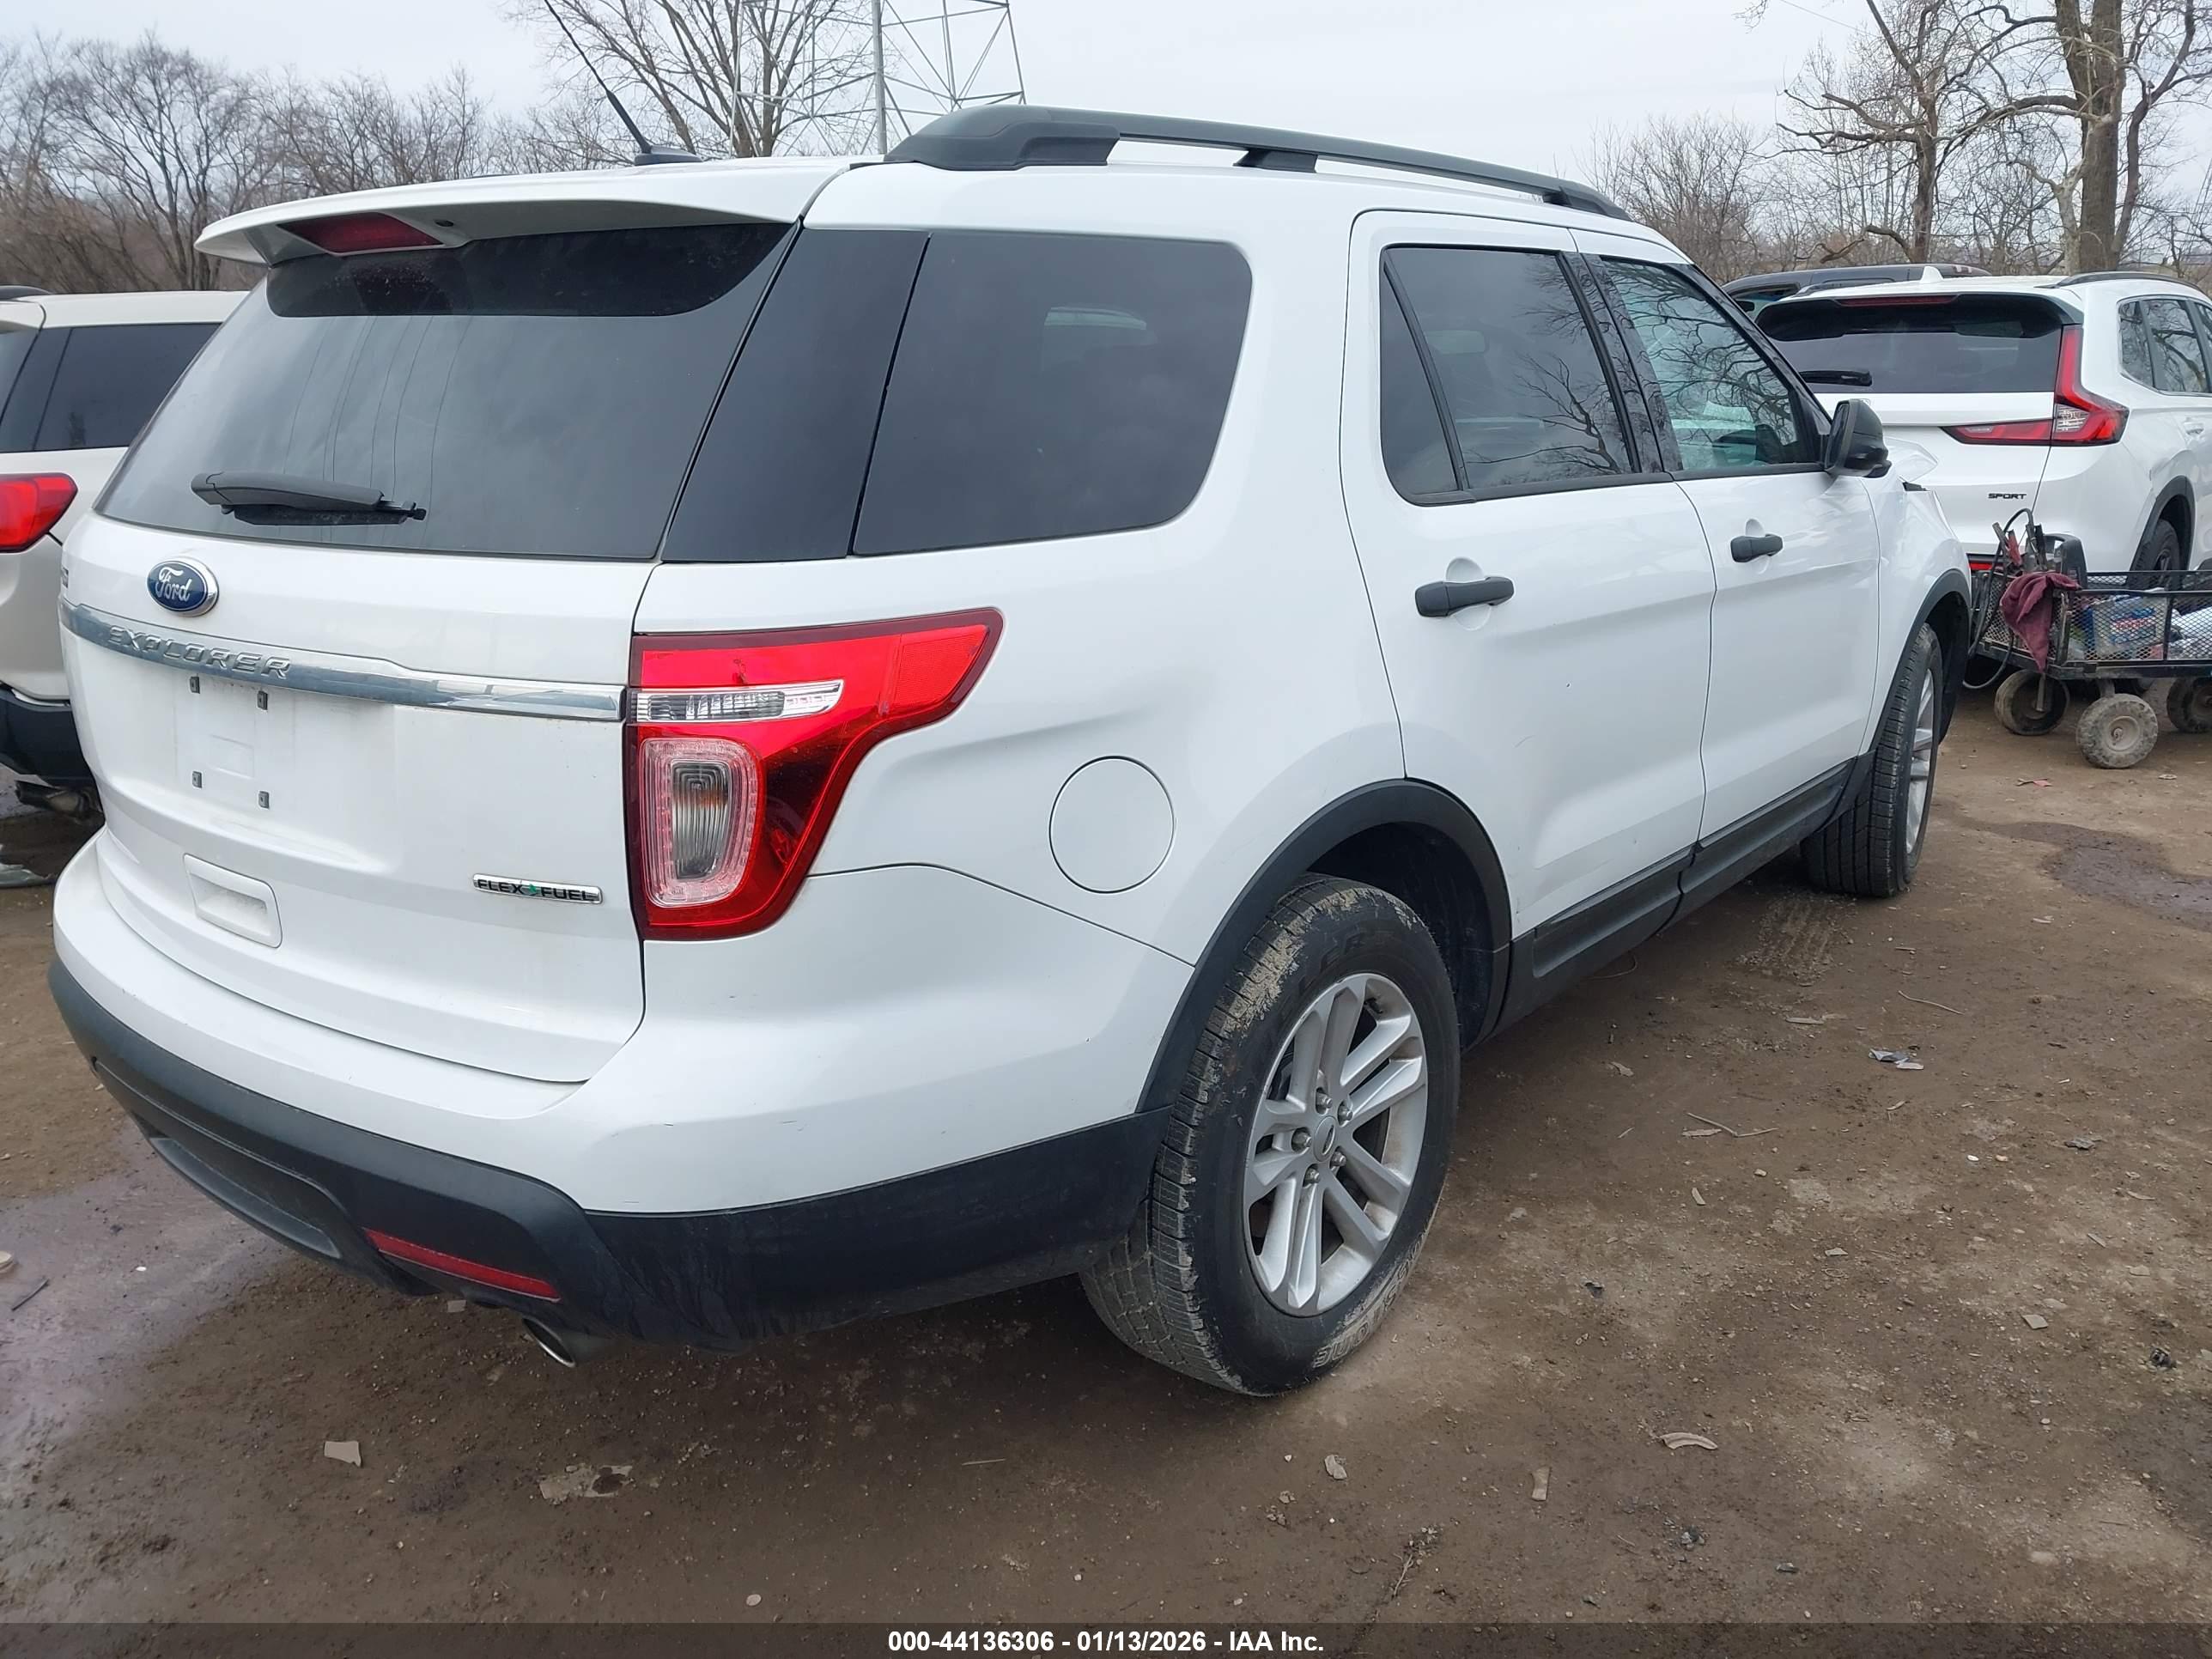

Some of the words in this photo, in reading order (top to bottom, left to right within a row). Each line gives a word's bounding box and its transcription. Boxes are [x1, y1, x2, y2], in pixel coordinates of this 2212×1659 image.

[155, 566, 193, 603] Ford
[107, 625, 291, 680] EXPLORER
[477, 878, 525, 895] FLEX
[541, 887, 595, 902] FUEL
